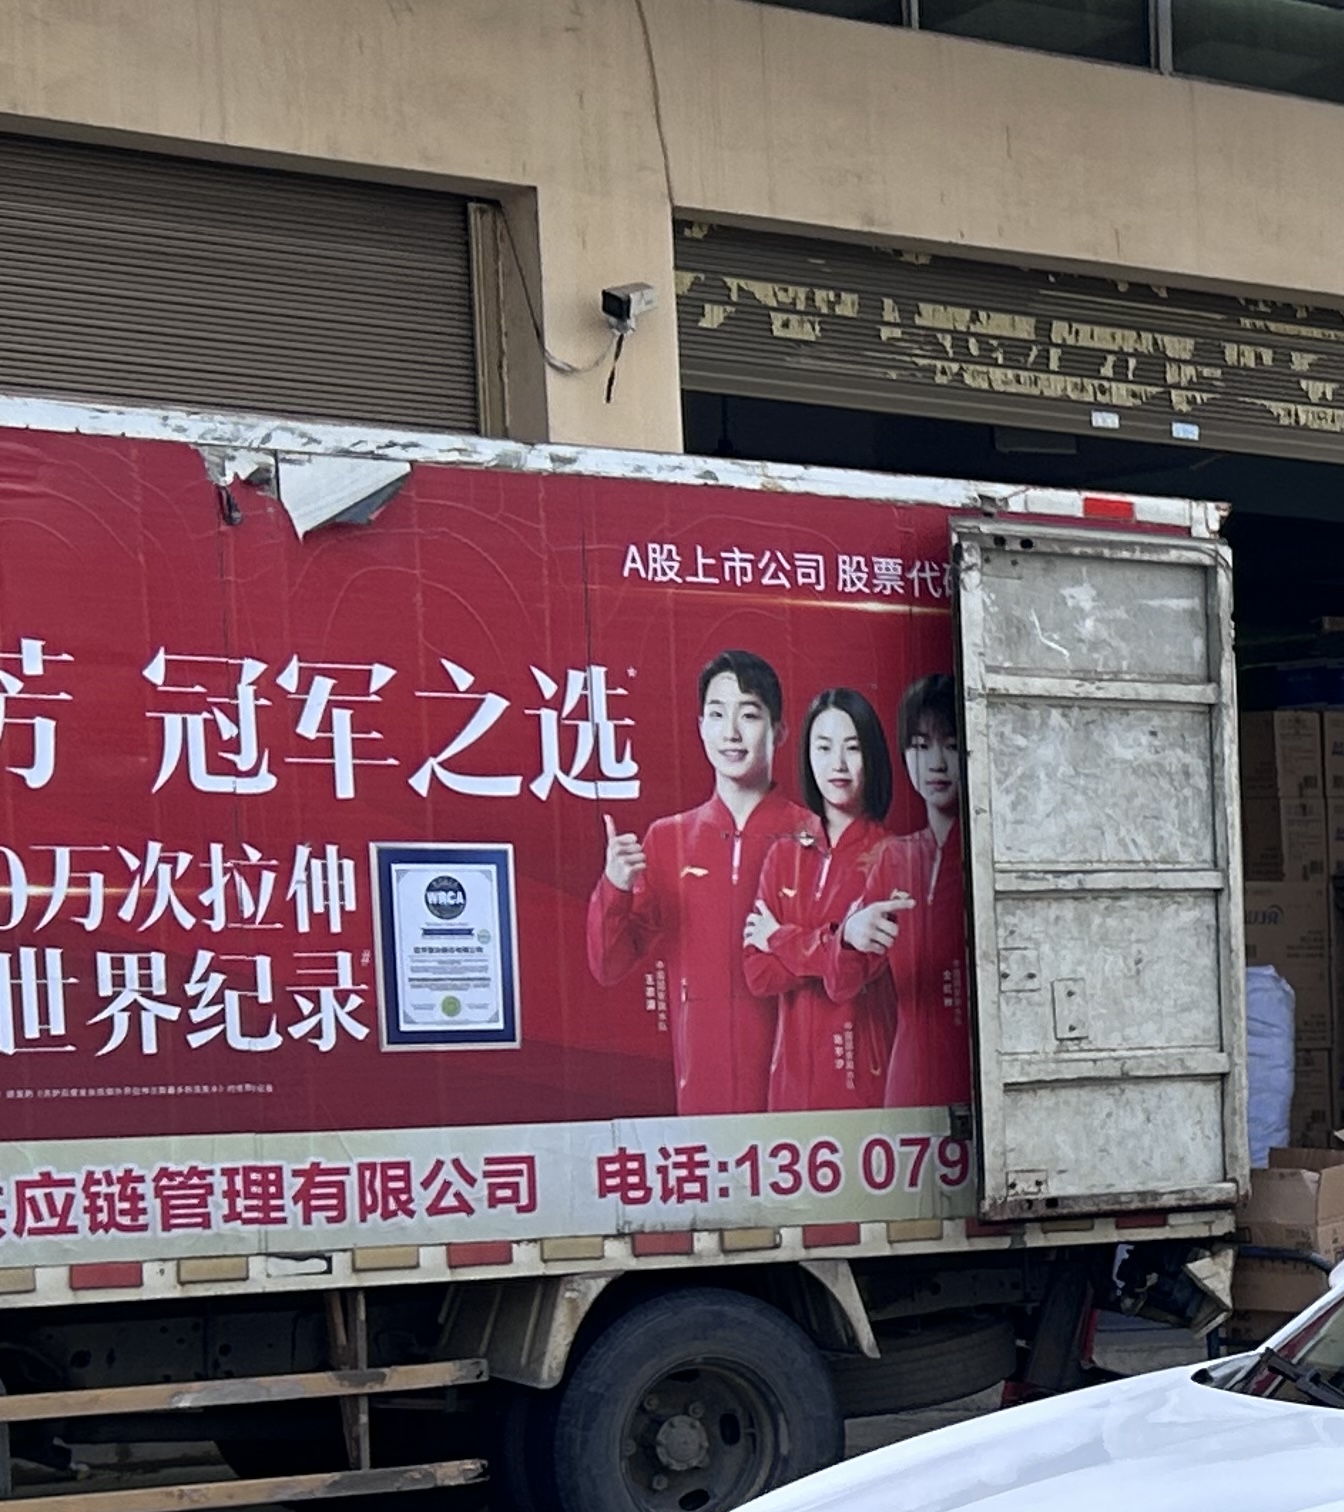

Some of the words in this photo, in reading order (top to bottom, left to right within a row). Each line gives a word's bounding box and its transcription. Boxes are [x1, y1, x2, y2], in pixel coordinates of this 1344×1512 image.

[623, 542, 826, 591] A股上市公司
[142, 646, 641, 801] 冠军之选
